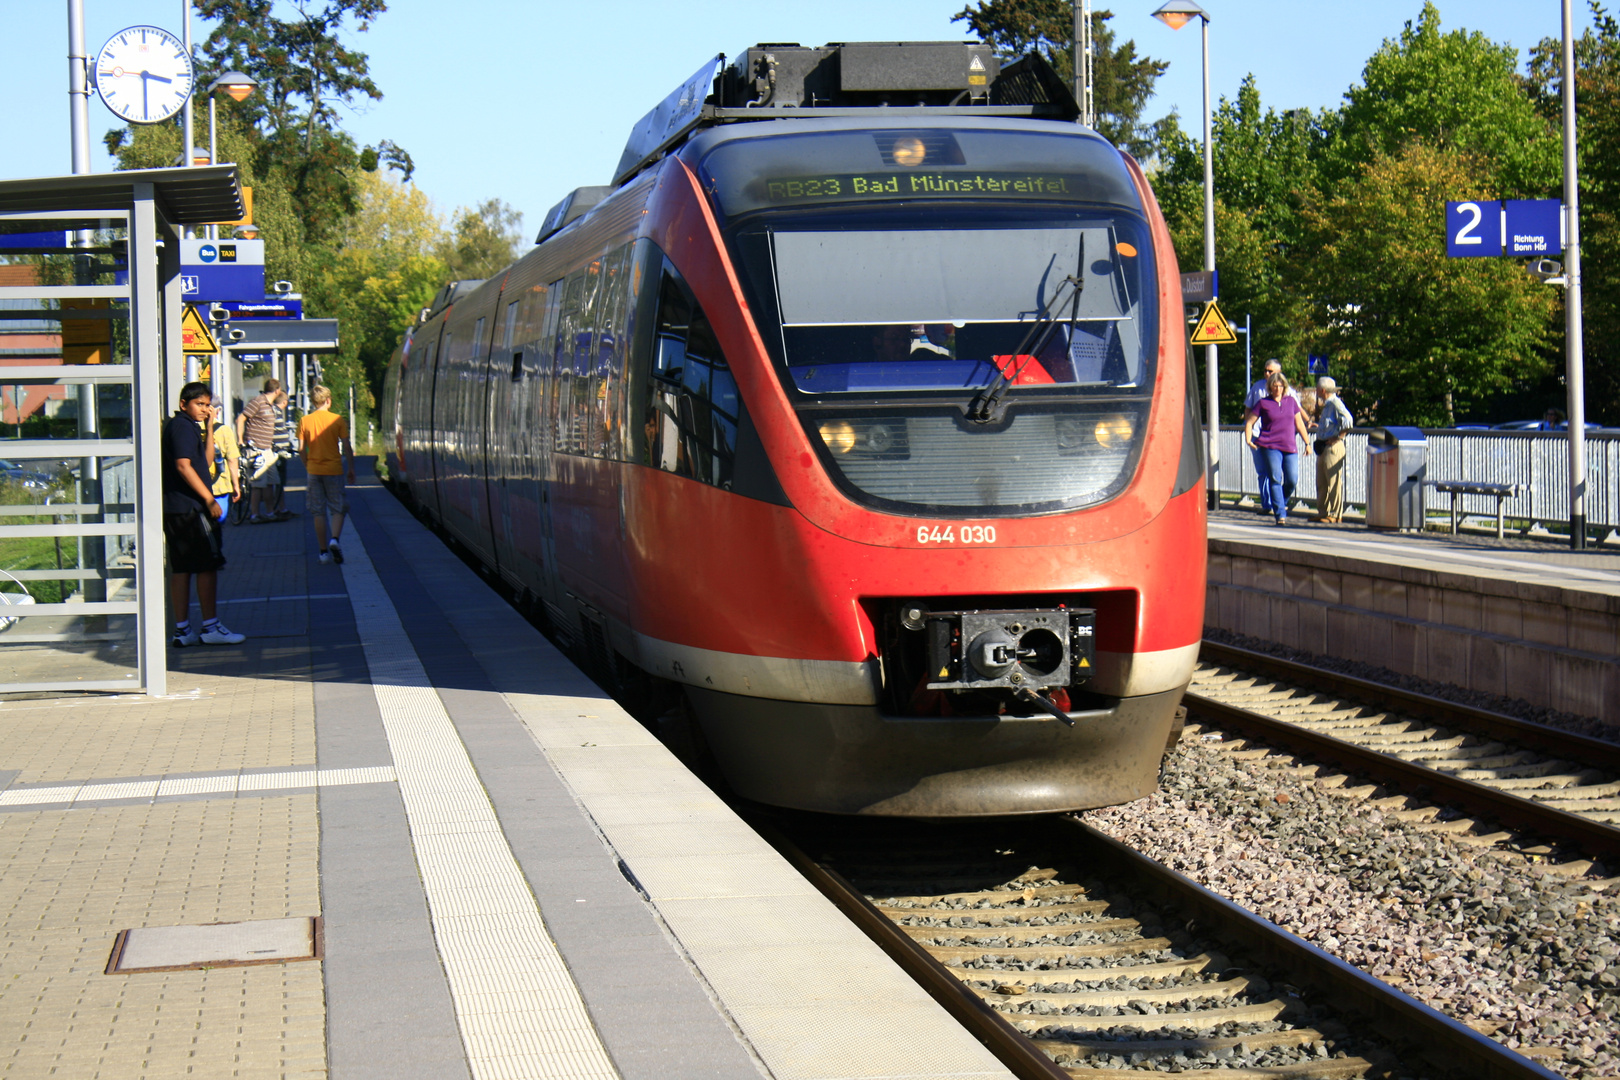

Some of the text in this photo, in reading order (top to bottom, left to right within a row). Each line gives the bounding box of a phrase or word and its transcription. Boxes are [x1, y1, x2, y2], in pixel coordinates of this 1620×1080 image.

[768, 175, 1070, 199] RB23 Bad Münstereifel
[1455, 202, 1482, 245] 2
[1514, 235, 1544, 243] Richtung
[201, 249, 215, 257] Bus
[1514, 243, 1532, 251] Bonn
[917, 525, 996, 544] 644 030
